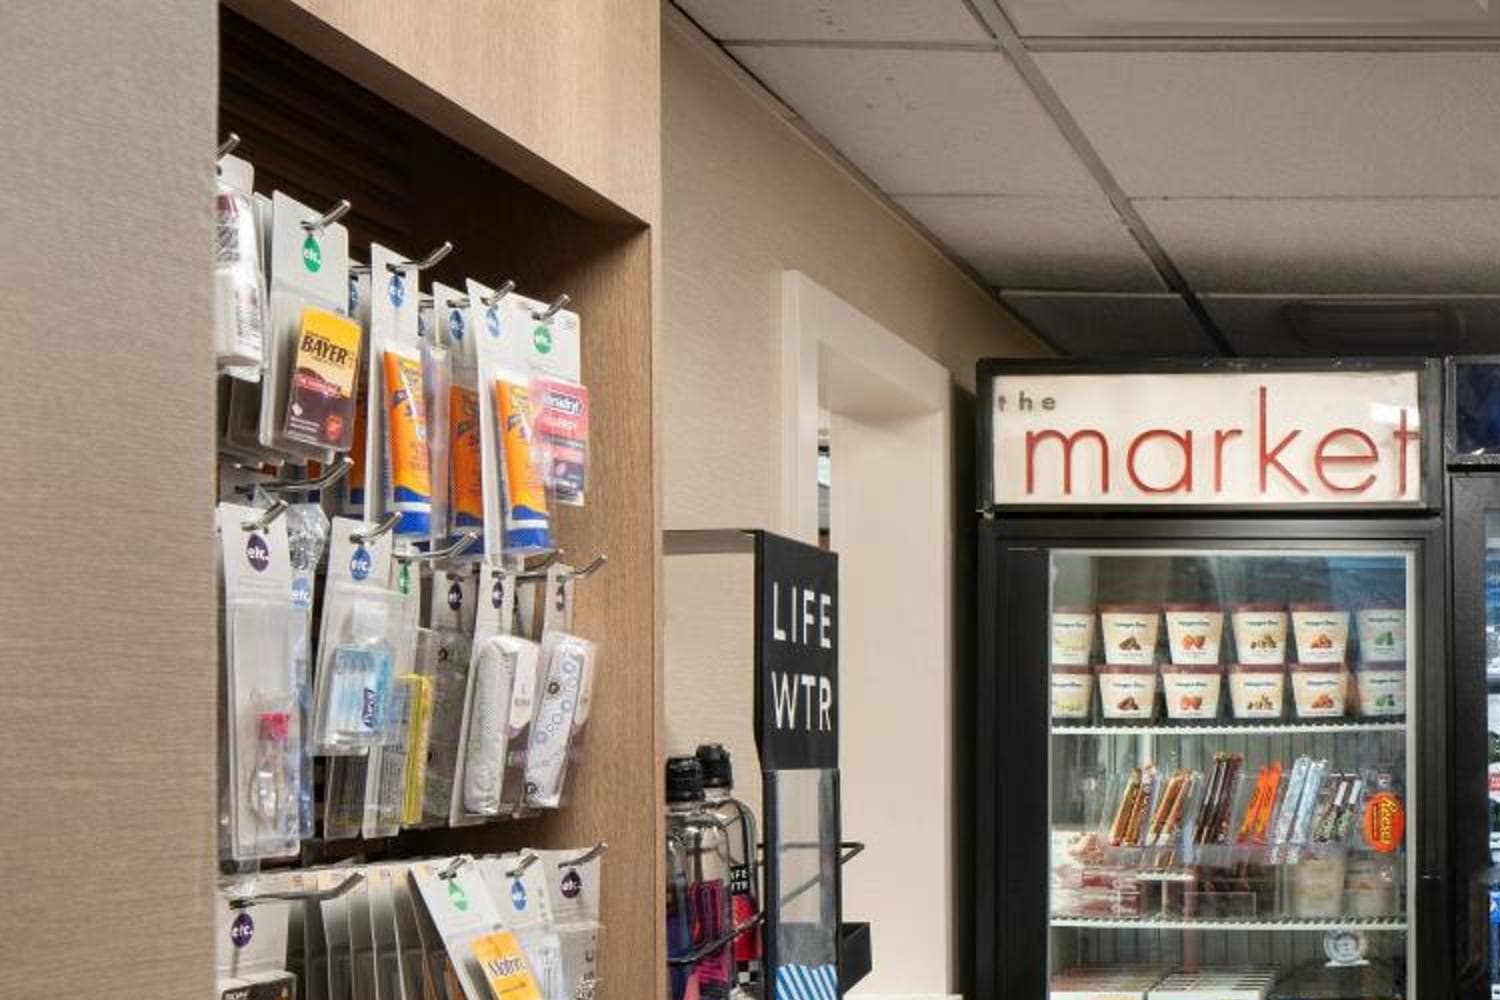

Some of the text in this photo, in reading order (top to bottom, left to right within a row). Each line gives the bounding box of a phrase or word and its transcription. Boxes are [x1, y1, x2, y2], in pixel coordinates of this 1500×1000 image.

[301, 334, 348, 365] BAYER
[1025, 386, 1422, 497] market
[772, 581, 832, 649] LIFE
[771, 671, 832, 731] WTR
